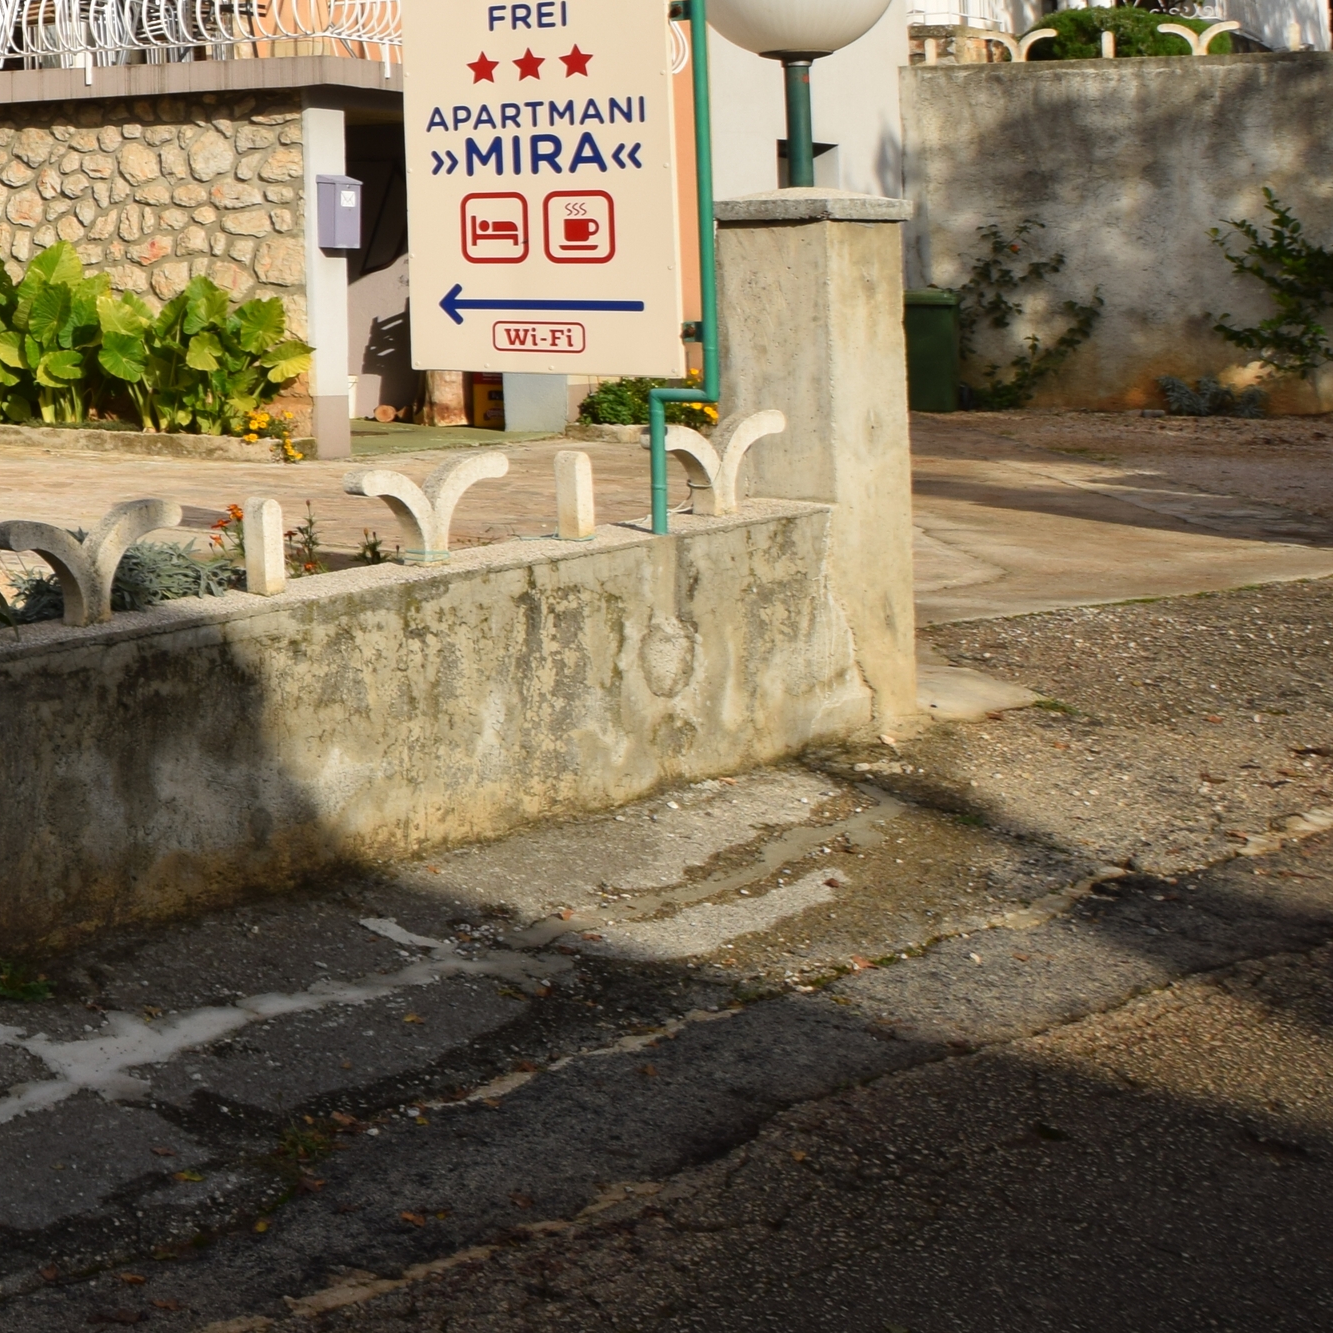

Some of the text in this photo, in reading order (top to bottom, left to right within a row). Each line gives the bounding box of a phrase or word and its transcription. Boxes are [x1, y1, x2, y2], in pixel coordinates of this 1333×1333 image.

[488, 0, 567, 31] FREI
[426, 95, 645, 132] APARTMANI
[504, 327, 574, 347] Wi-Fi
